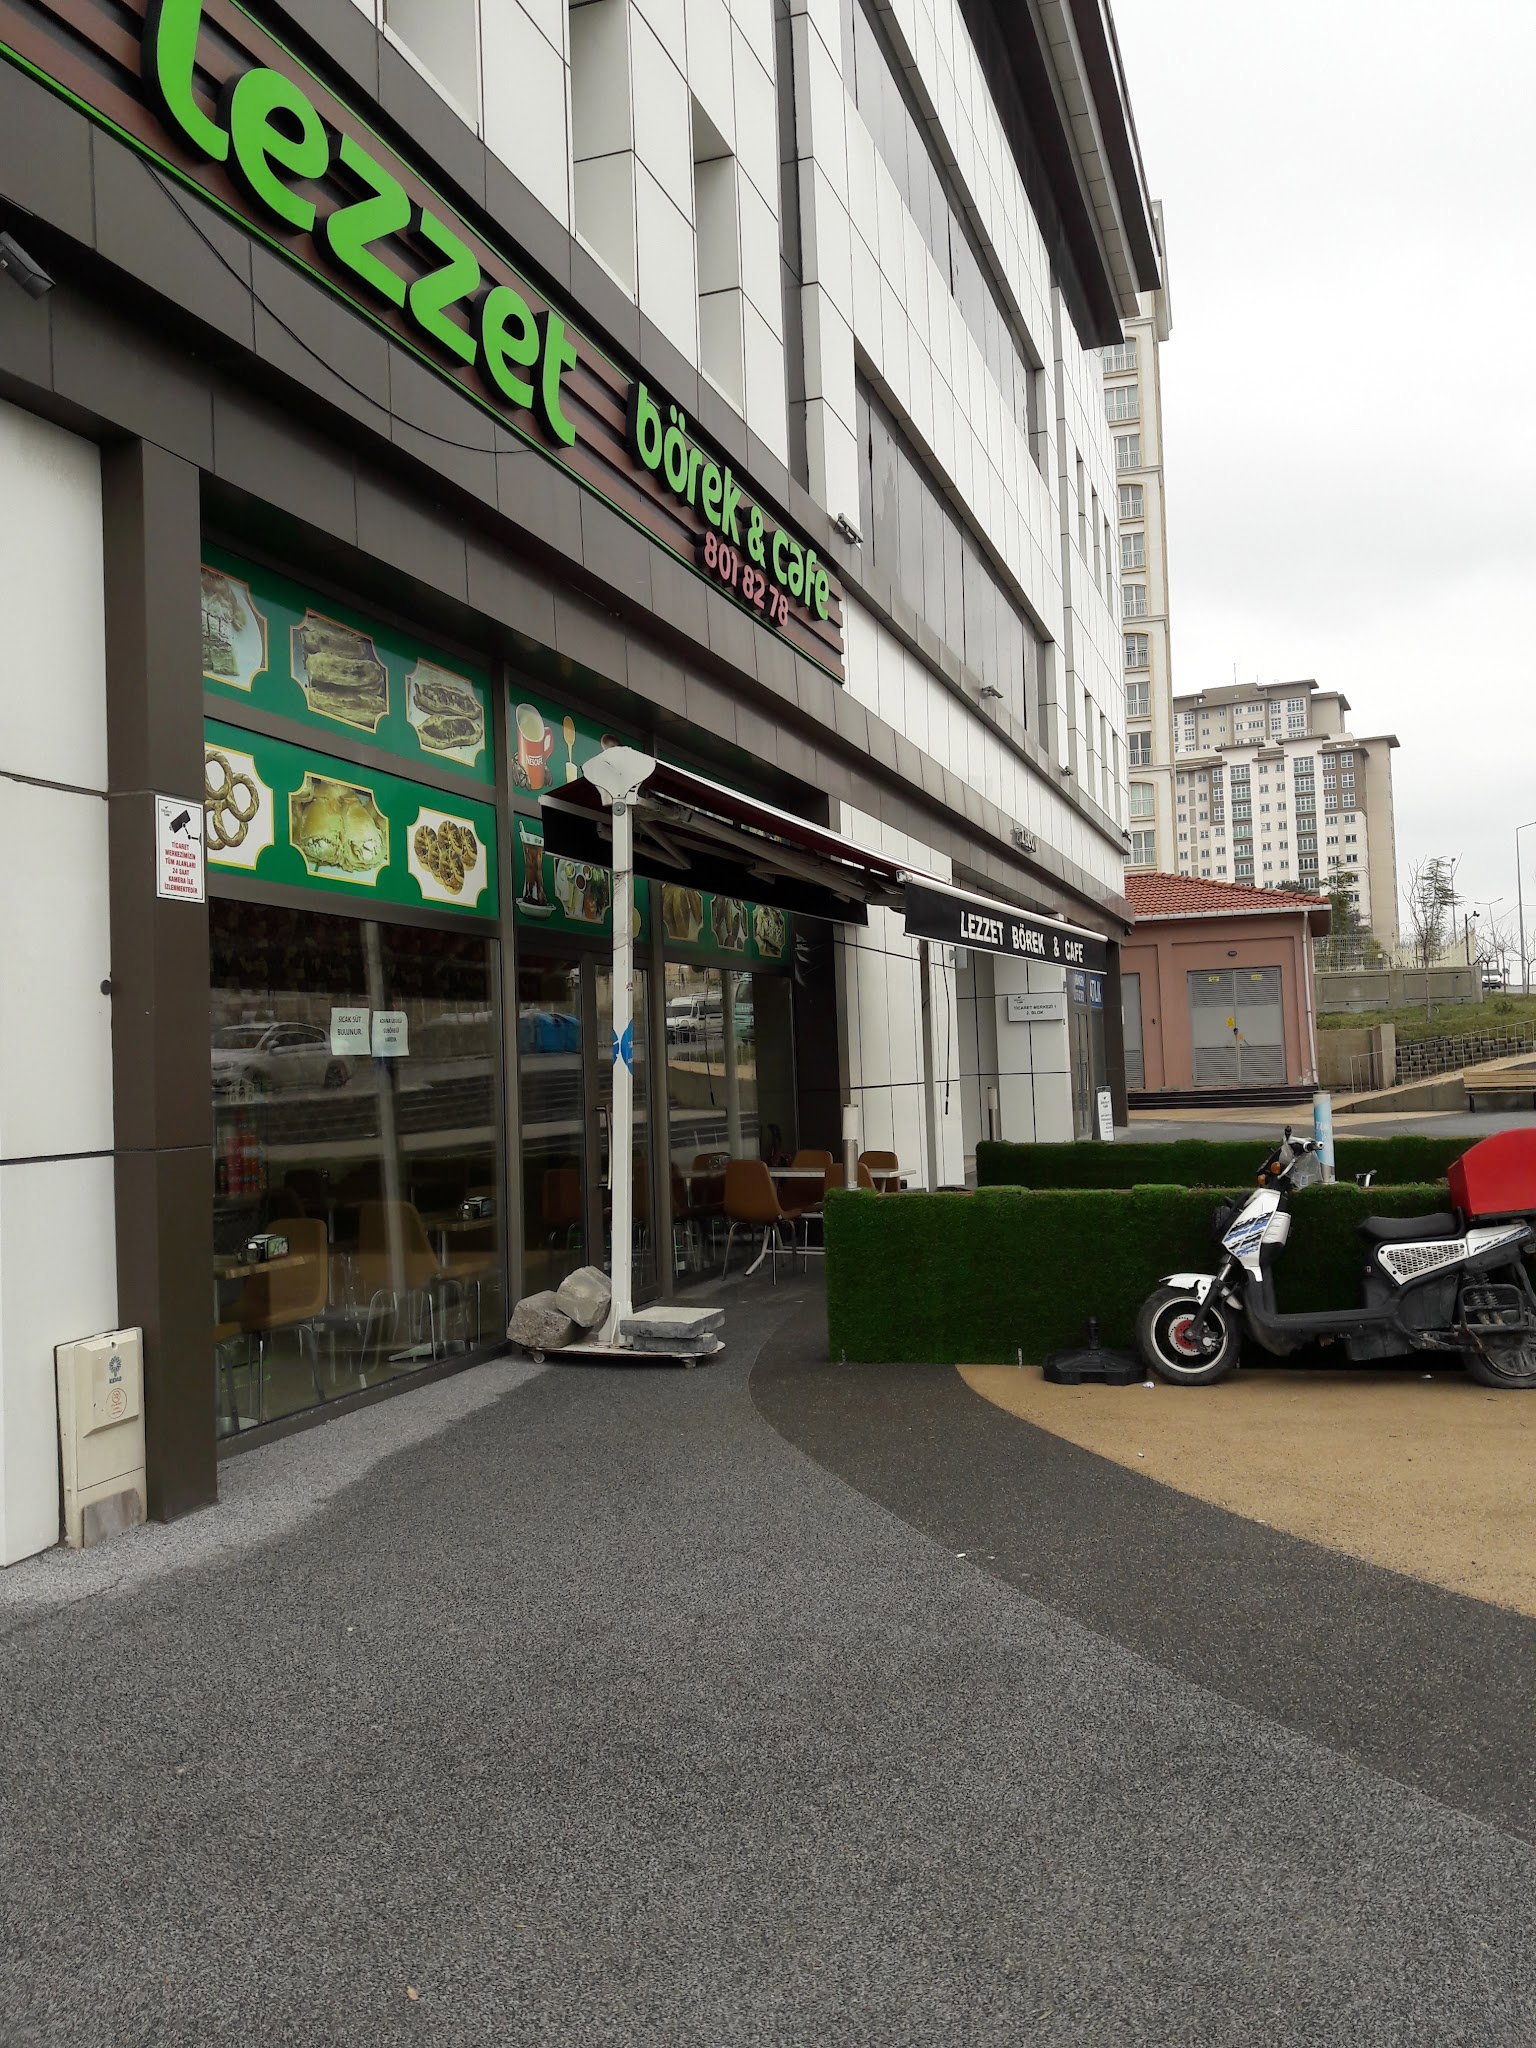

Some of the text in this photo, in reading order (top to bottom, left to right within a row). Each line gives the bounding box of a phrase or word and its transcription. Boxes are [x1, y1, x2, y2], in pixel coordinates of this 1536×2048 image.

[636, 381, 830, 621] börek & cafe
[703, 530, 790, 627] 801 82 78
[171, 841, 190, 851] TİCARET
[164, 848, 196, 860] MERKEZİMİZİN
[165, 857, 196, 869] TÜM ALANLARI
[179, 868, 190, 876] SAAT
[168, 875, 187, 885] KAMERA
[164, 883, 198, 894] İZLENMEKTEDİR
[960, 910, 1084, 963] LEZZET BÖREK & CAFE
